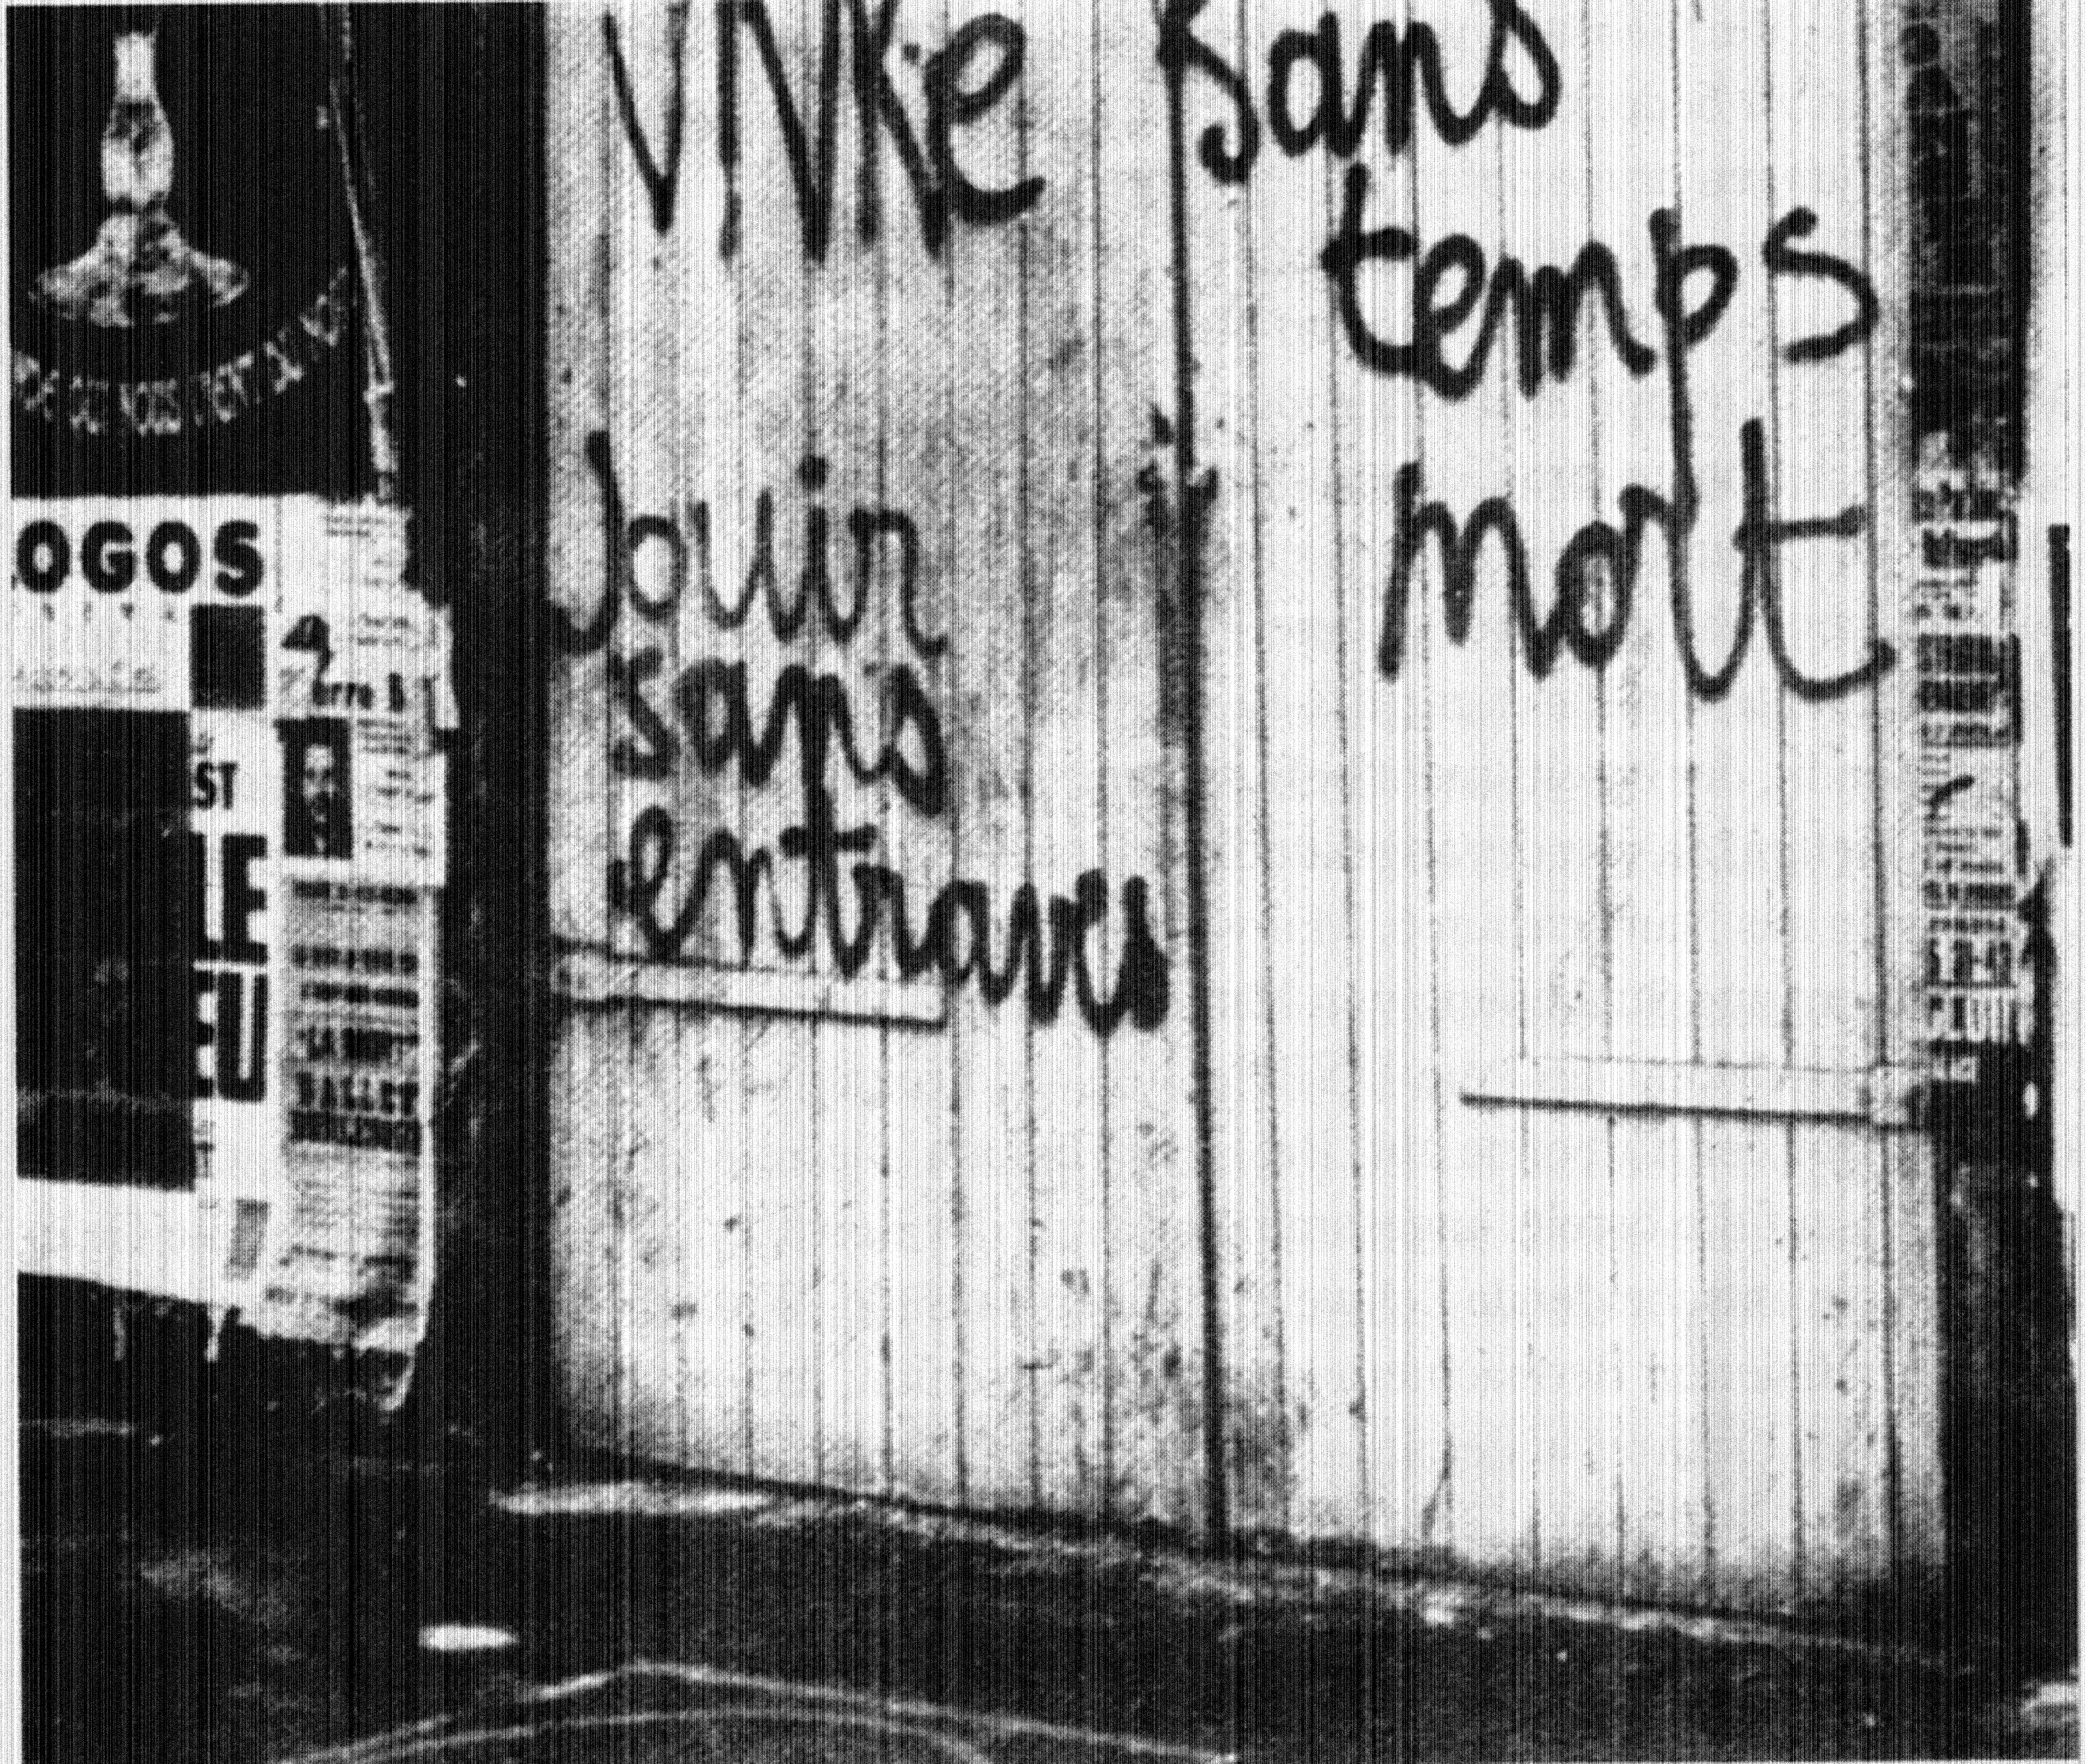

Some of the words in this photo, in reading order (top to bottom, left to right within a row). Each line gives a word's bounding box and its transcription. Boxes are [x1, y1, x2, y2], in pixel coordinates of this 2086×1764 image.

[1318, 161, 1880, 481] temps
[11, 519, 264, 597] OGOS
[614, 646, 946, 817] sans
